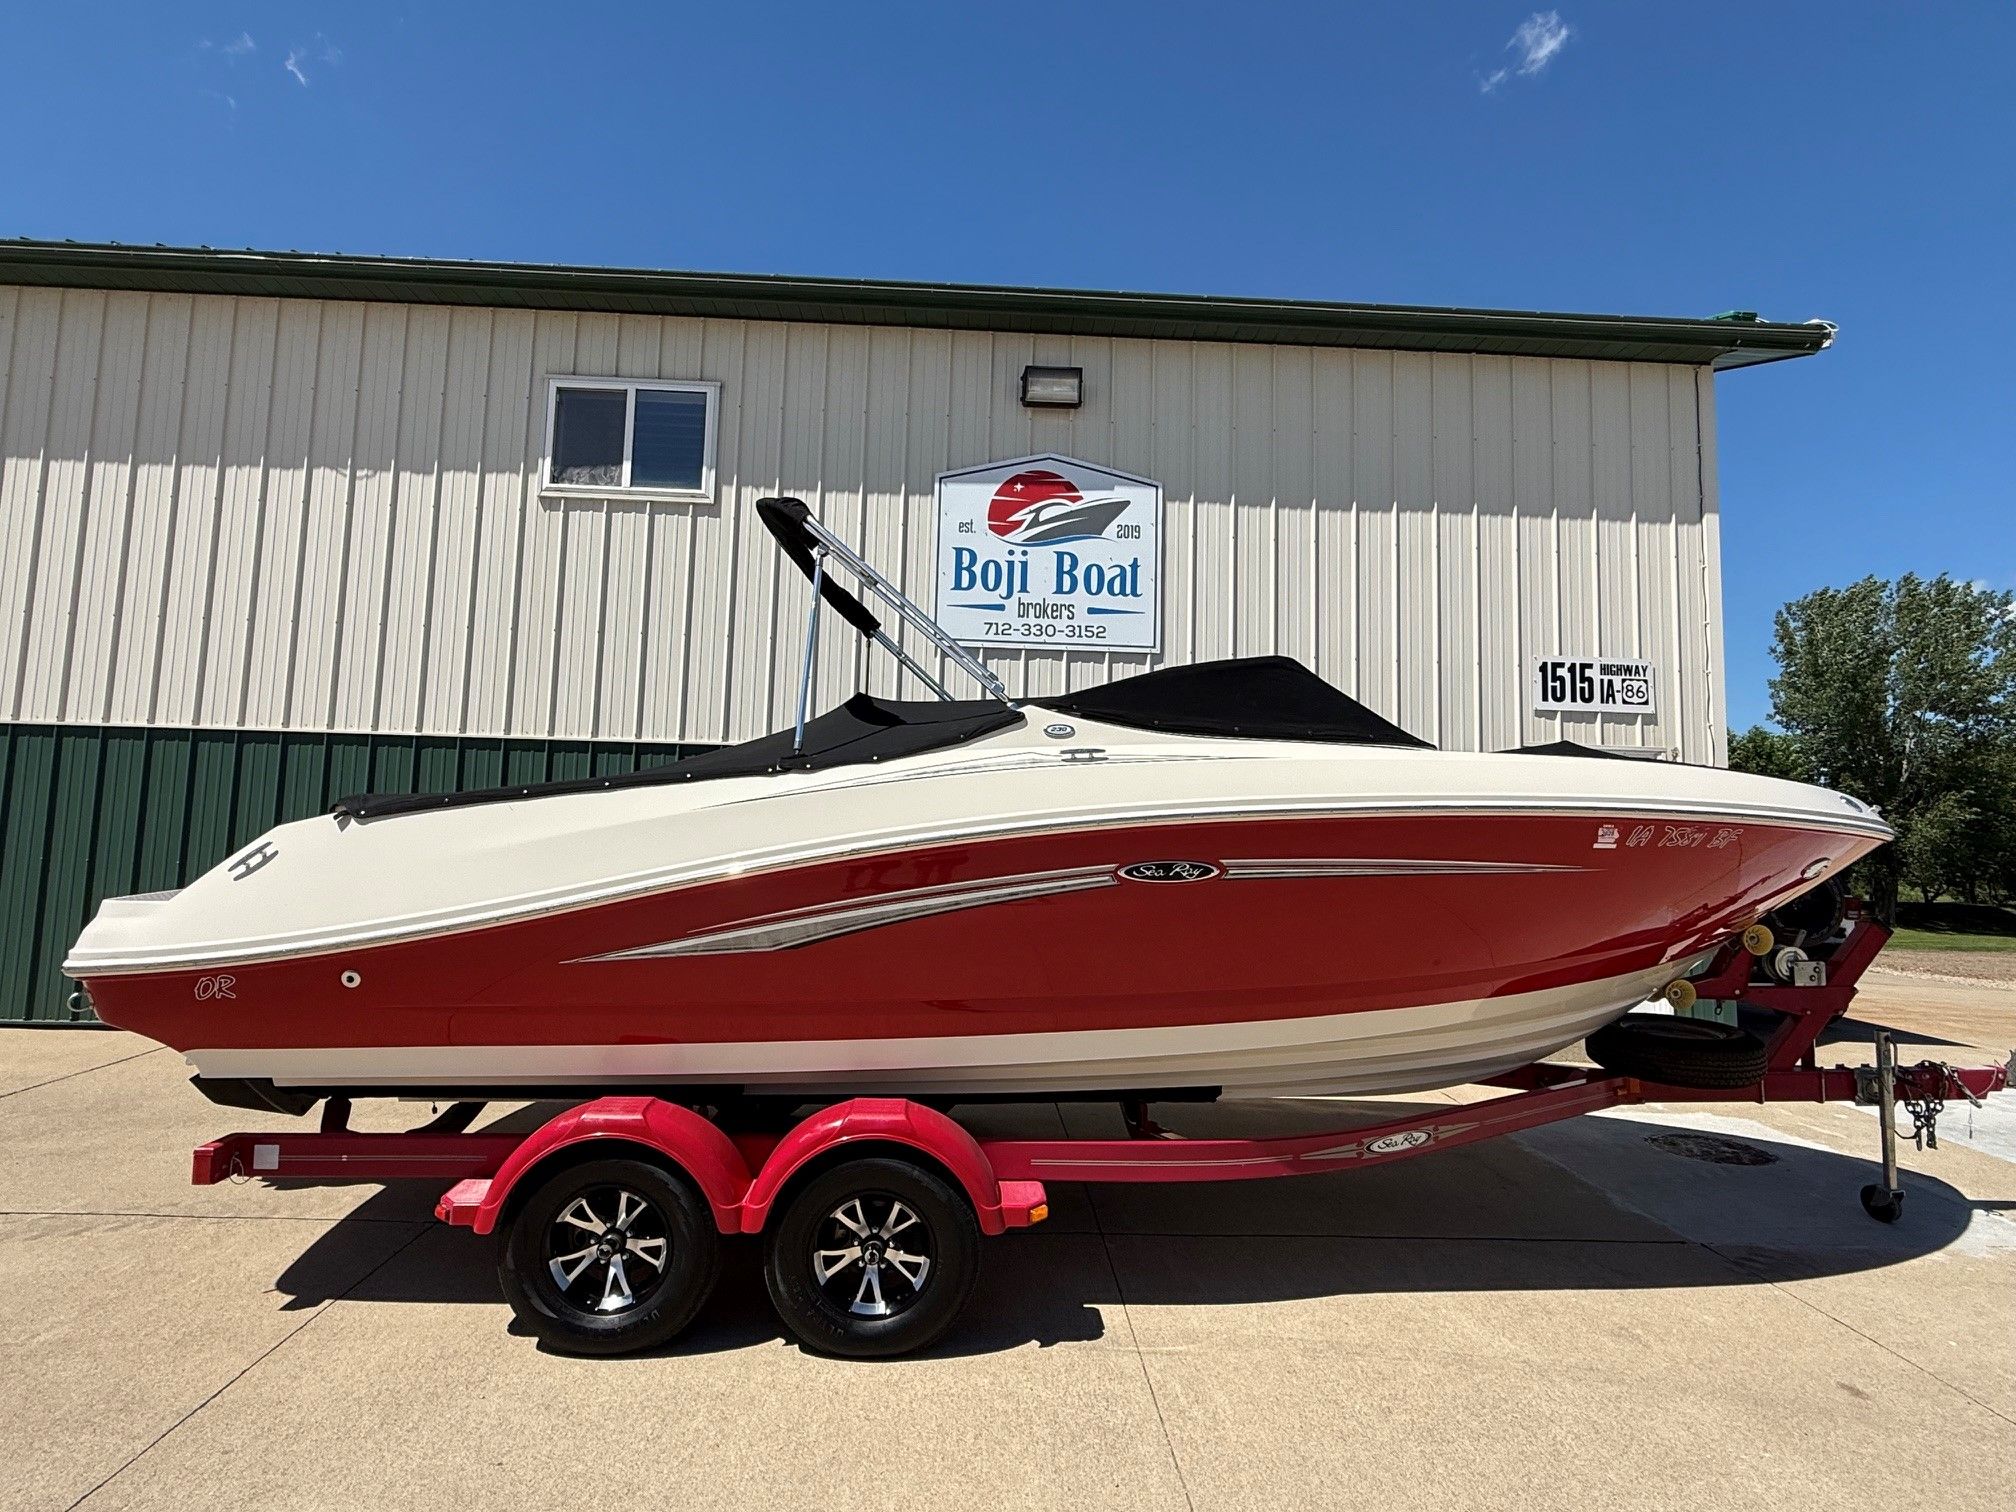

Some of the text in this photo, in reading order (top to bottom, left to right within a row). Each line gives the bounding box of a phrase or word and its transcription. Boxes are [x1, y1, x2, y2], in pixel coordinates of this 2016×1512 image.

[958, 519, 976, 534] est.
[1116, 524, 1141, 540] 2019
[950, 546, 1144, 600] Boji Boat
[1017, 597, 1075, 620] brokers
[983, 622, 1107, 639] 712-330-3152
[1599, 663, 1648, 677] HIGHWAY
[1539, 661, 1595, 704] 1515
[1625, 825, 1655, 848] IA
[1133, 863, 1204, 880] Sea Ray
[194, 974, 237, 1001] OR
[1377, 1132, 1422, 1150] Sea Ray
